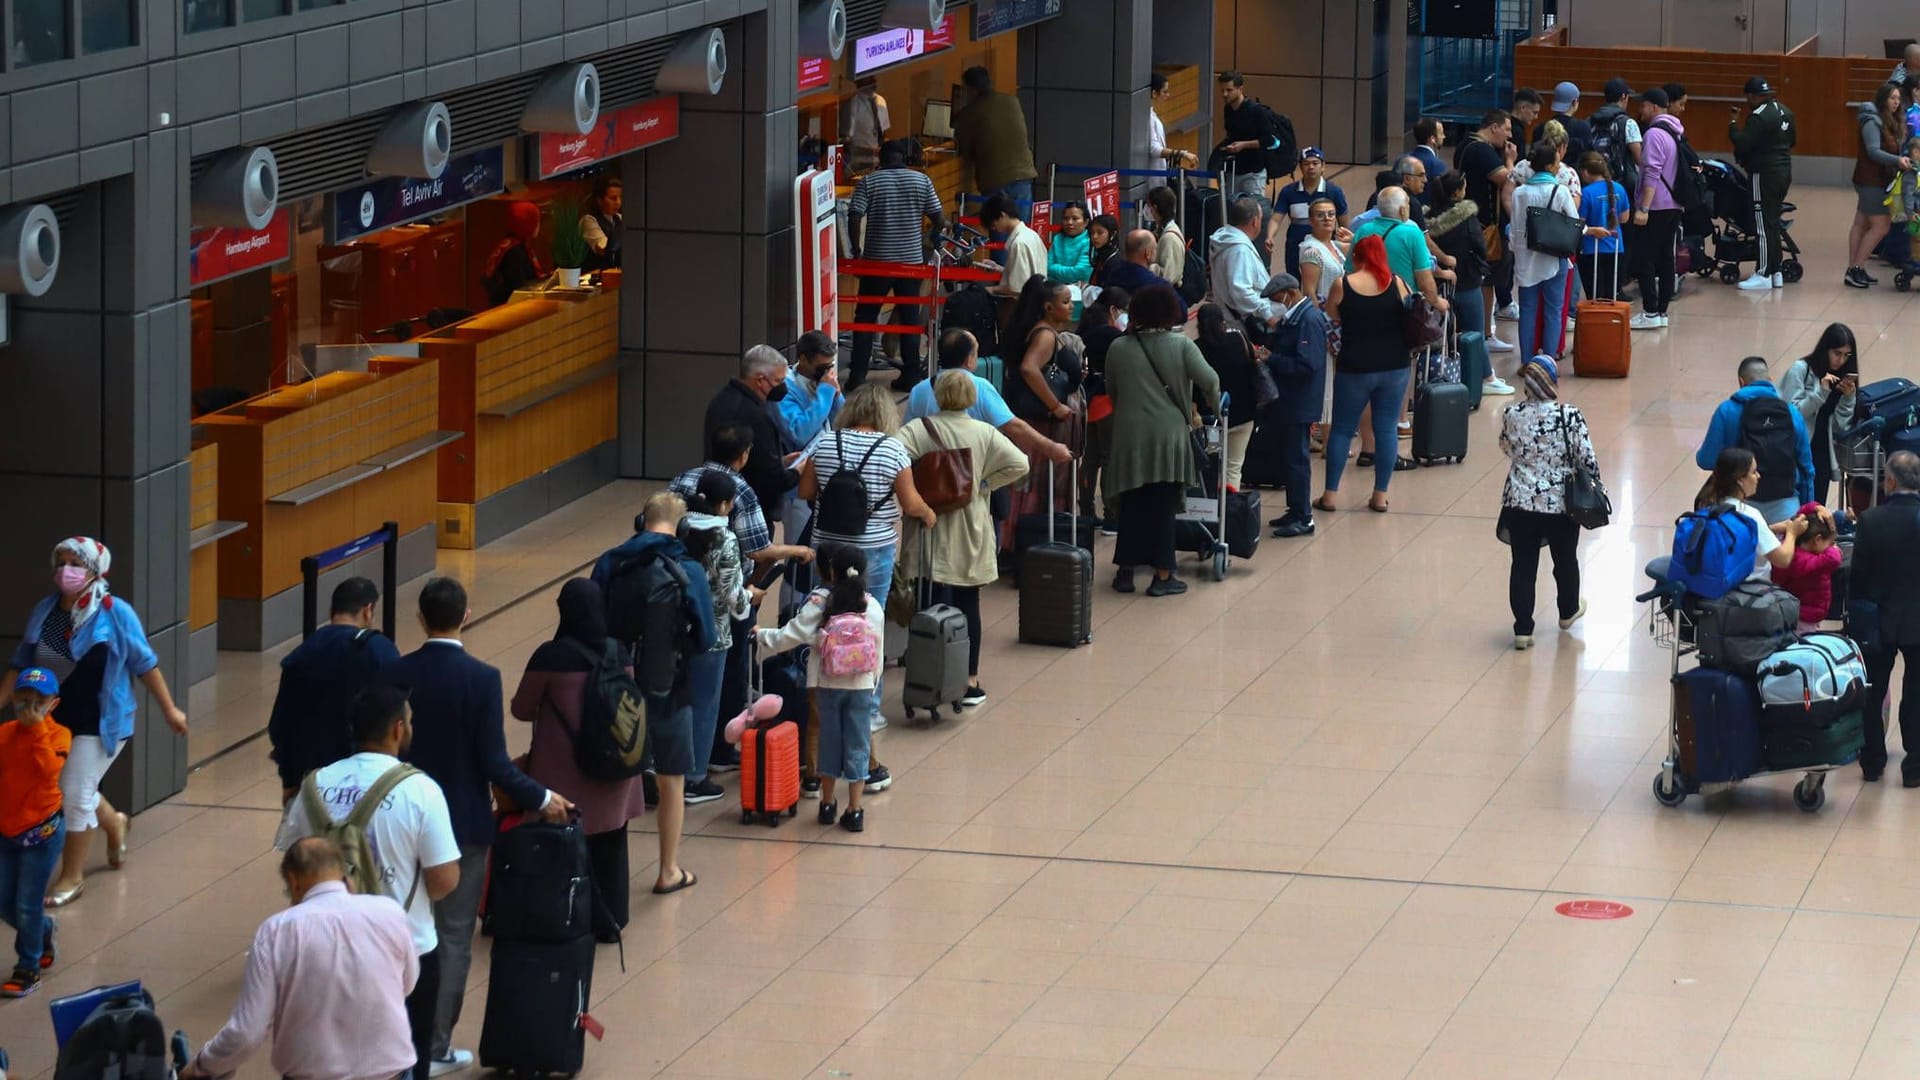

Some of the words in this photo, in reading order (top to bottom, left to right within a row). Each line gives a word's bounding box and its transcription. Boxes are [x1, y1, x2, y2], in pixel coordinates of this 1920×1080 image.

[865, 43, 886, 59] TURKISH
[886, 37, 905, 52] AIRLINES
[401, 188, 413, 207] Tel
[415, 183, 432, 203] Aviv
[433, 179, 444, 199] Air
[226, 241, 250, 256] Hamburg
[251, 232, 270, 248] Airport
